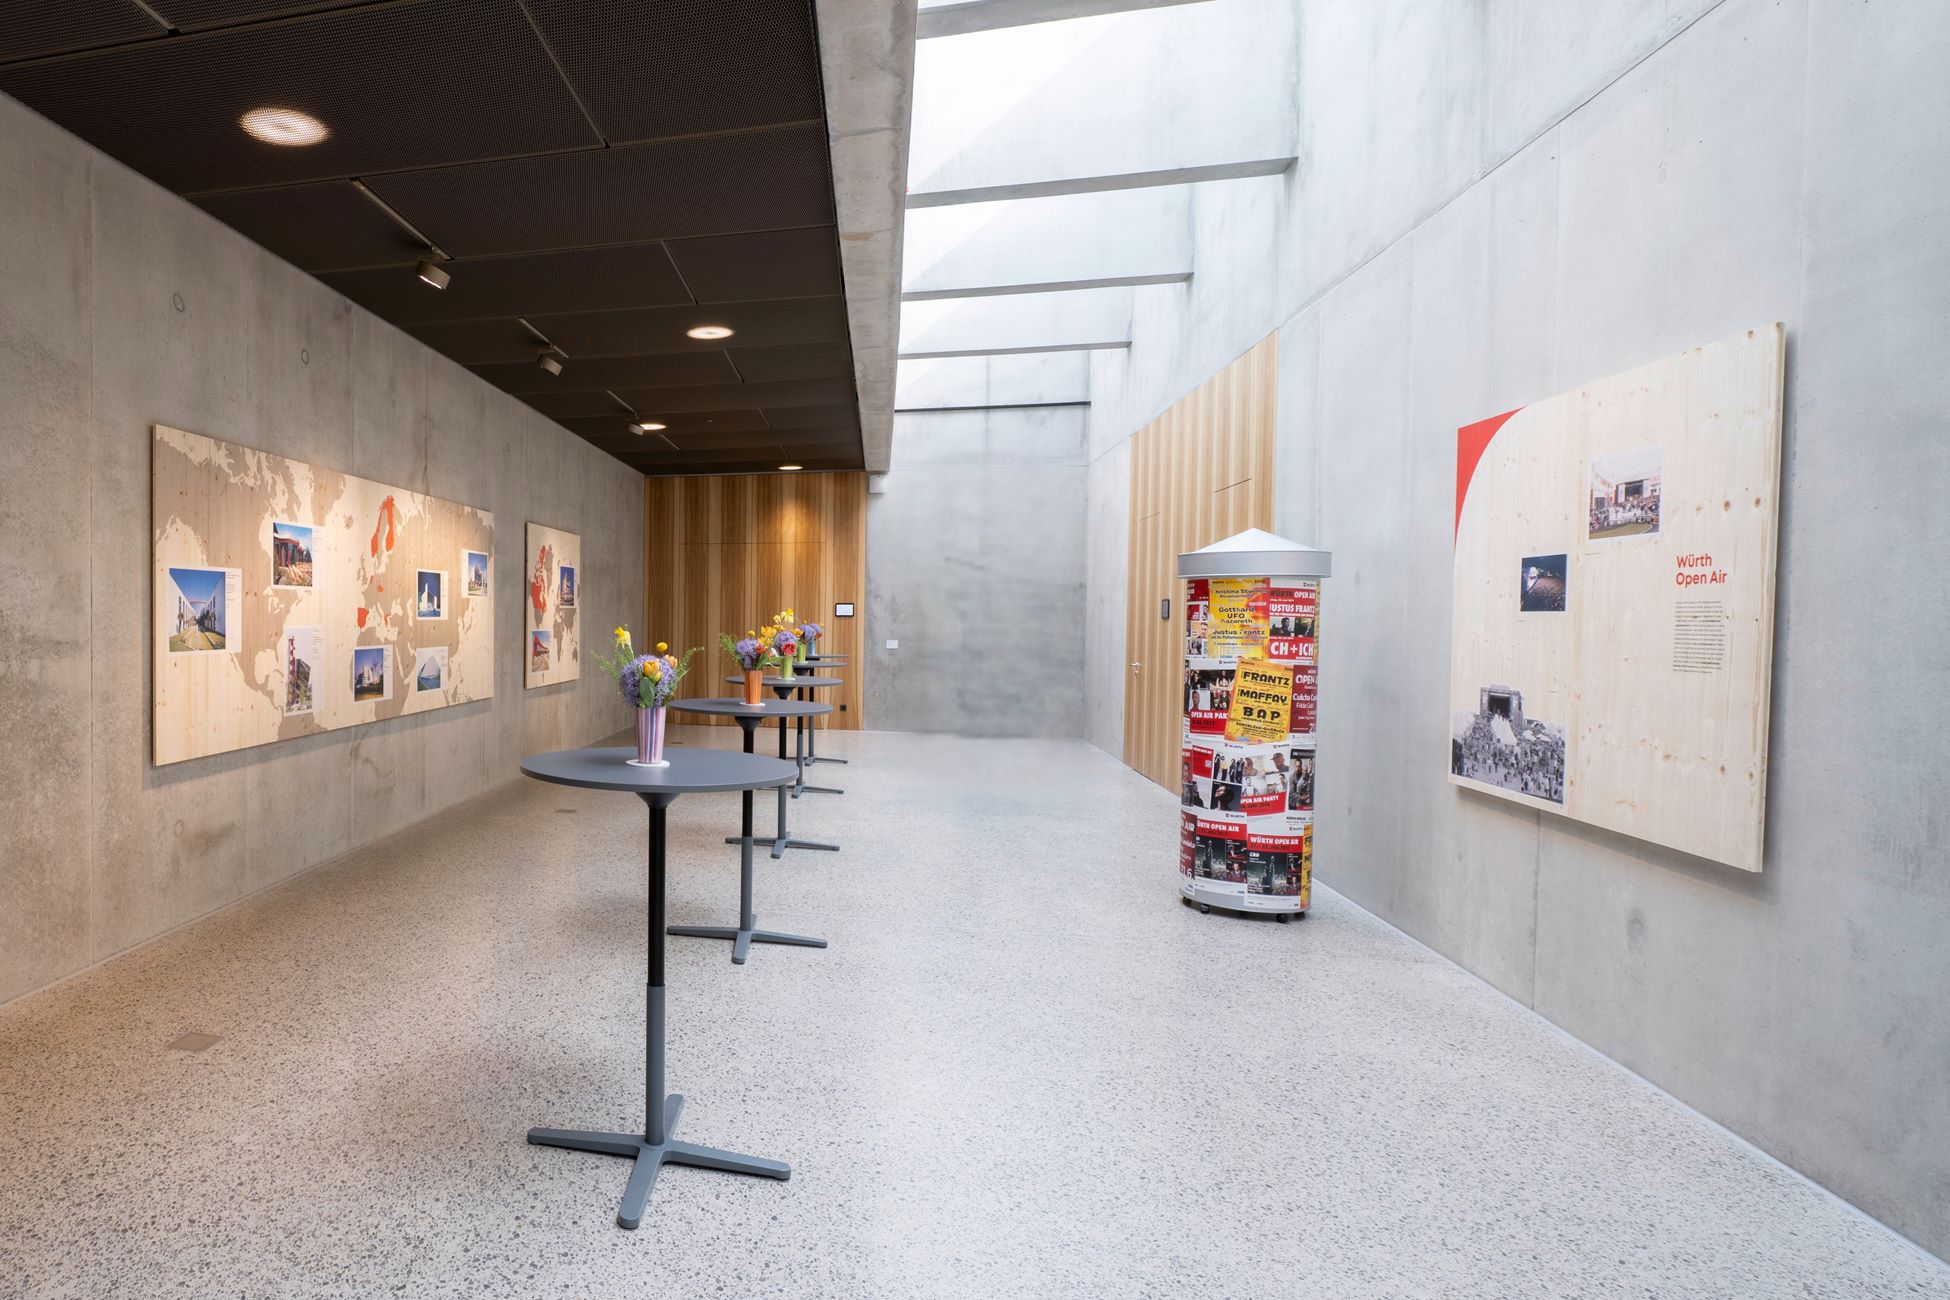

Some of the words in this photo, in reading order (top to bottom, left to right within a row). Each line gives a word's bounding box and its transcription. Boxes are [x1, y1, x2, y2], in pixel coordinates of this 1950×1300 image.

[1676, 554, 1712, 568] Würth
[1676, 572, 1707, 588] Open
[1710, 570, 1728, 584] Air
[1270, 641, 1288, 655] CH
[1299, 643, 1313, 656] ICH
[1243, 672, 1290, 686] FRANTZ
[1240, 689, 1287, 704] MAFFAY
[1185, 822, 1195, 832] AIR
